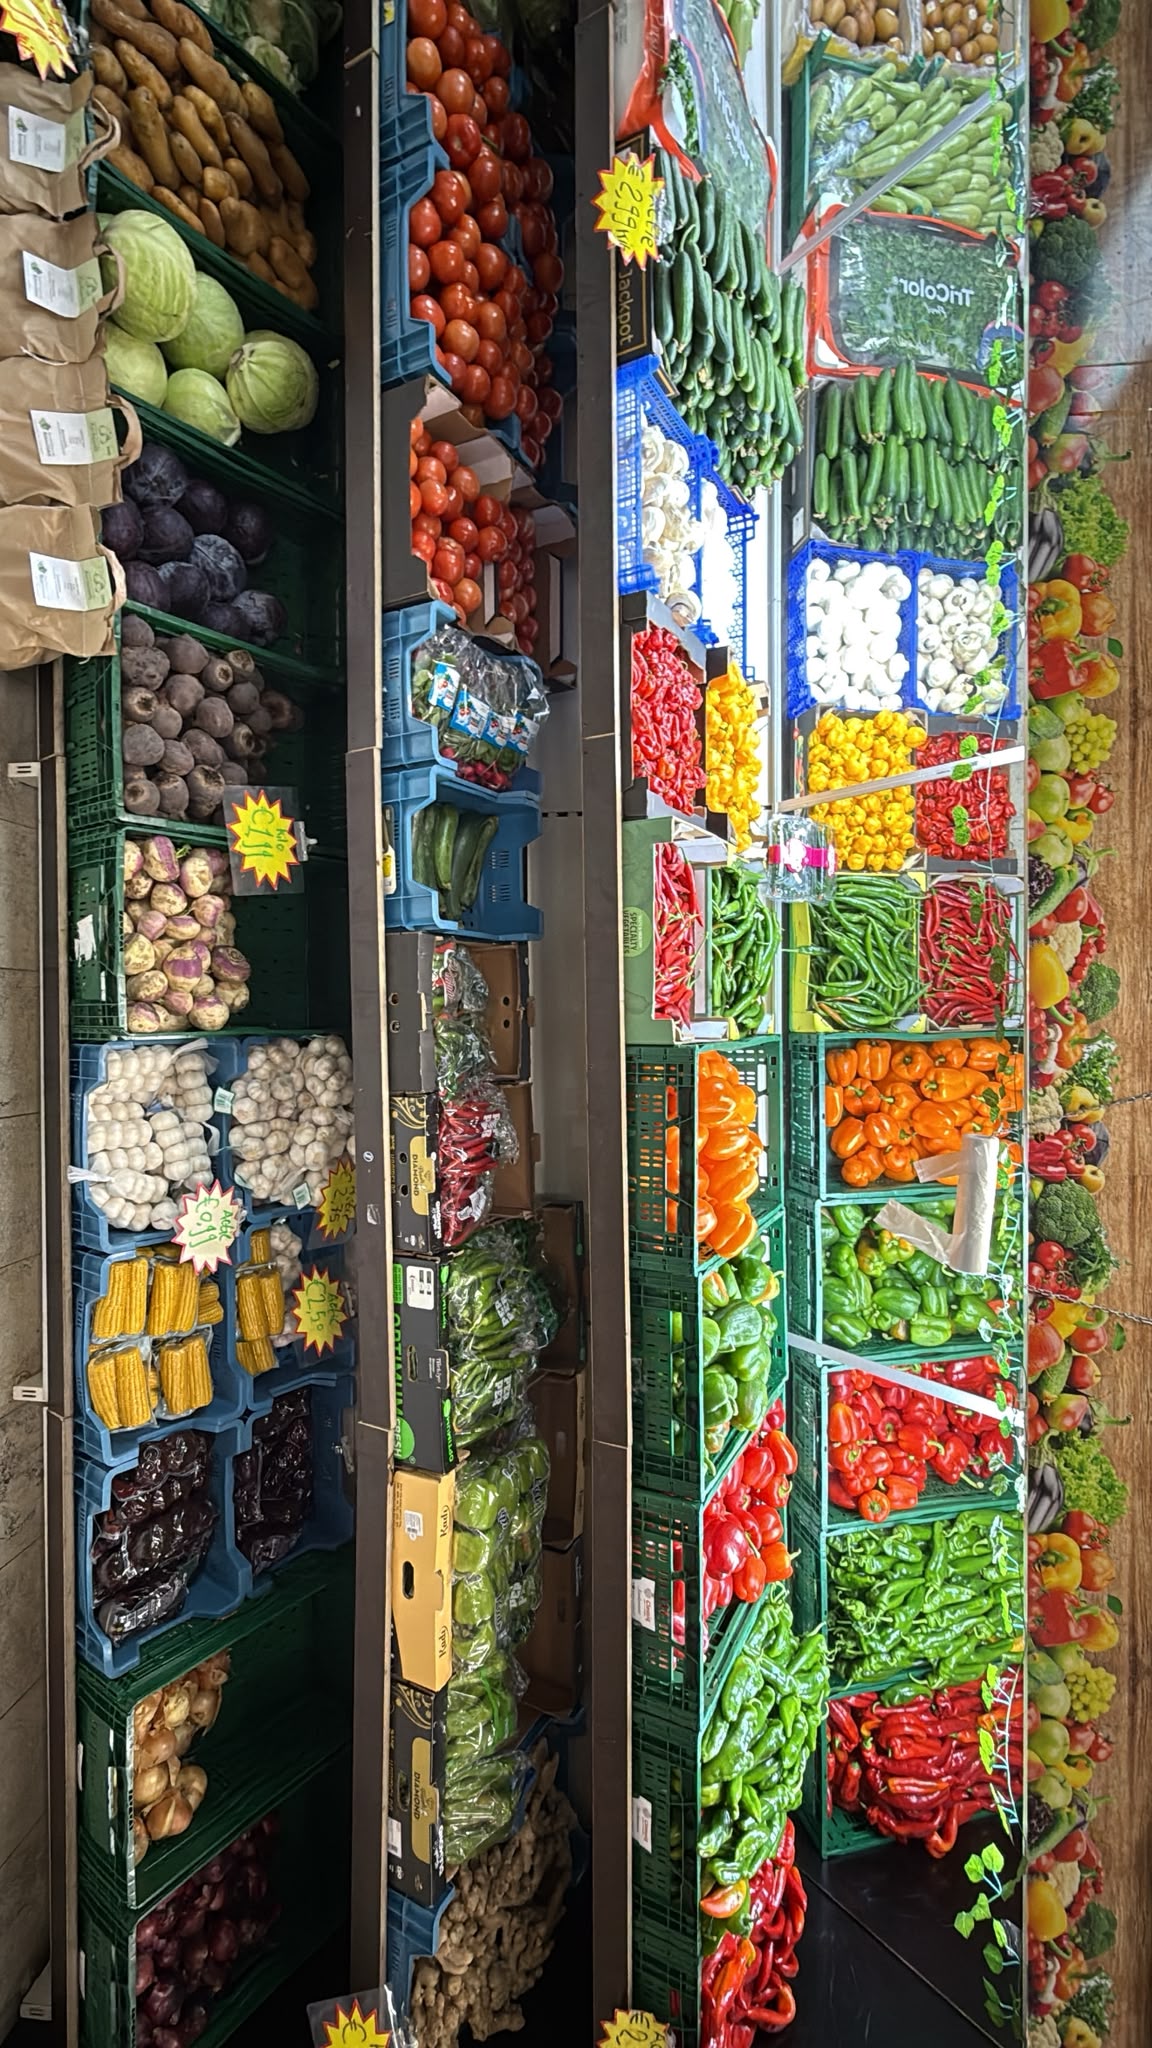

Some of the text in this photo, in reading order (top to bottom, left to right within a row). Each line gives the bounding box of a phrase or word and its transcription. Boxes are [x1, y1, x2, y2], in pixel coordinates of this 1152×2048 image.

[616, 272, 633, 346] Jackpot
[630, 912, 638, 951] SPECIALTY
[412, 1154, 420, 1196] DIAMOND
